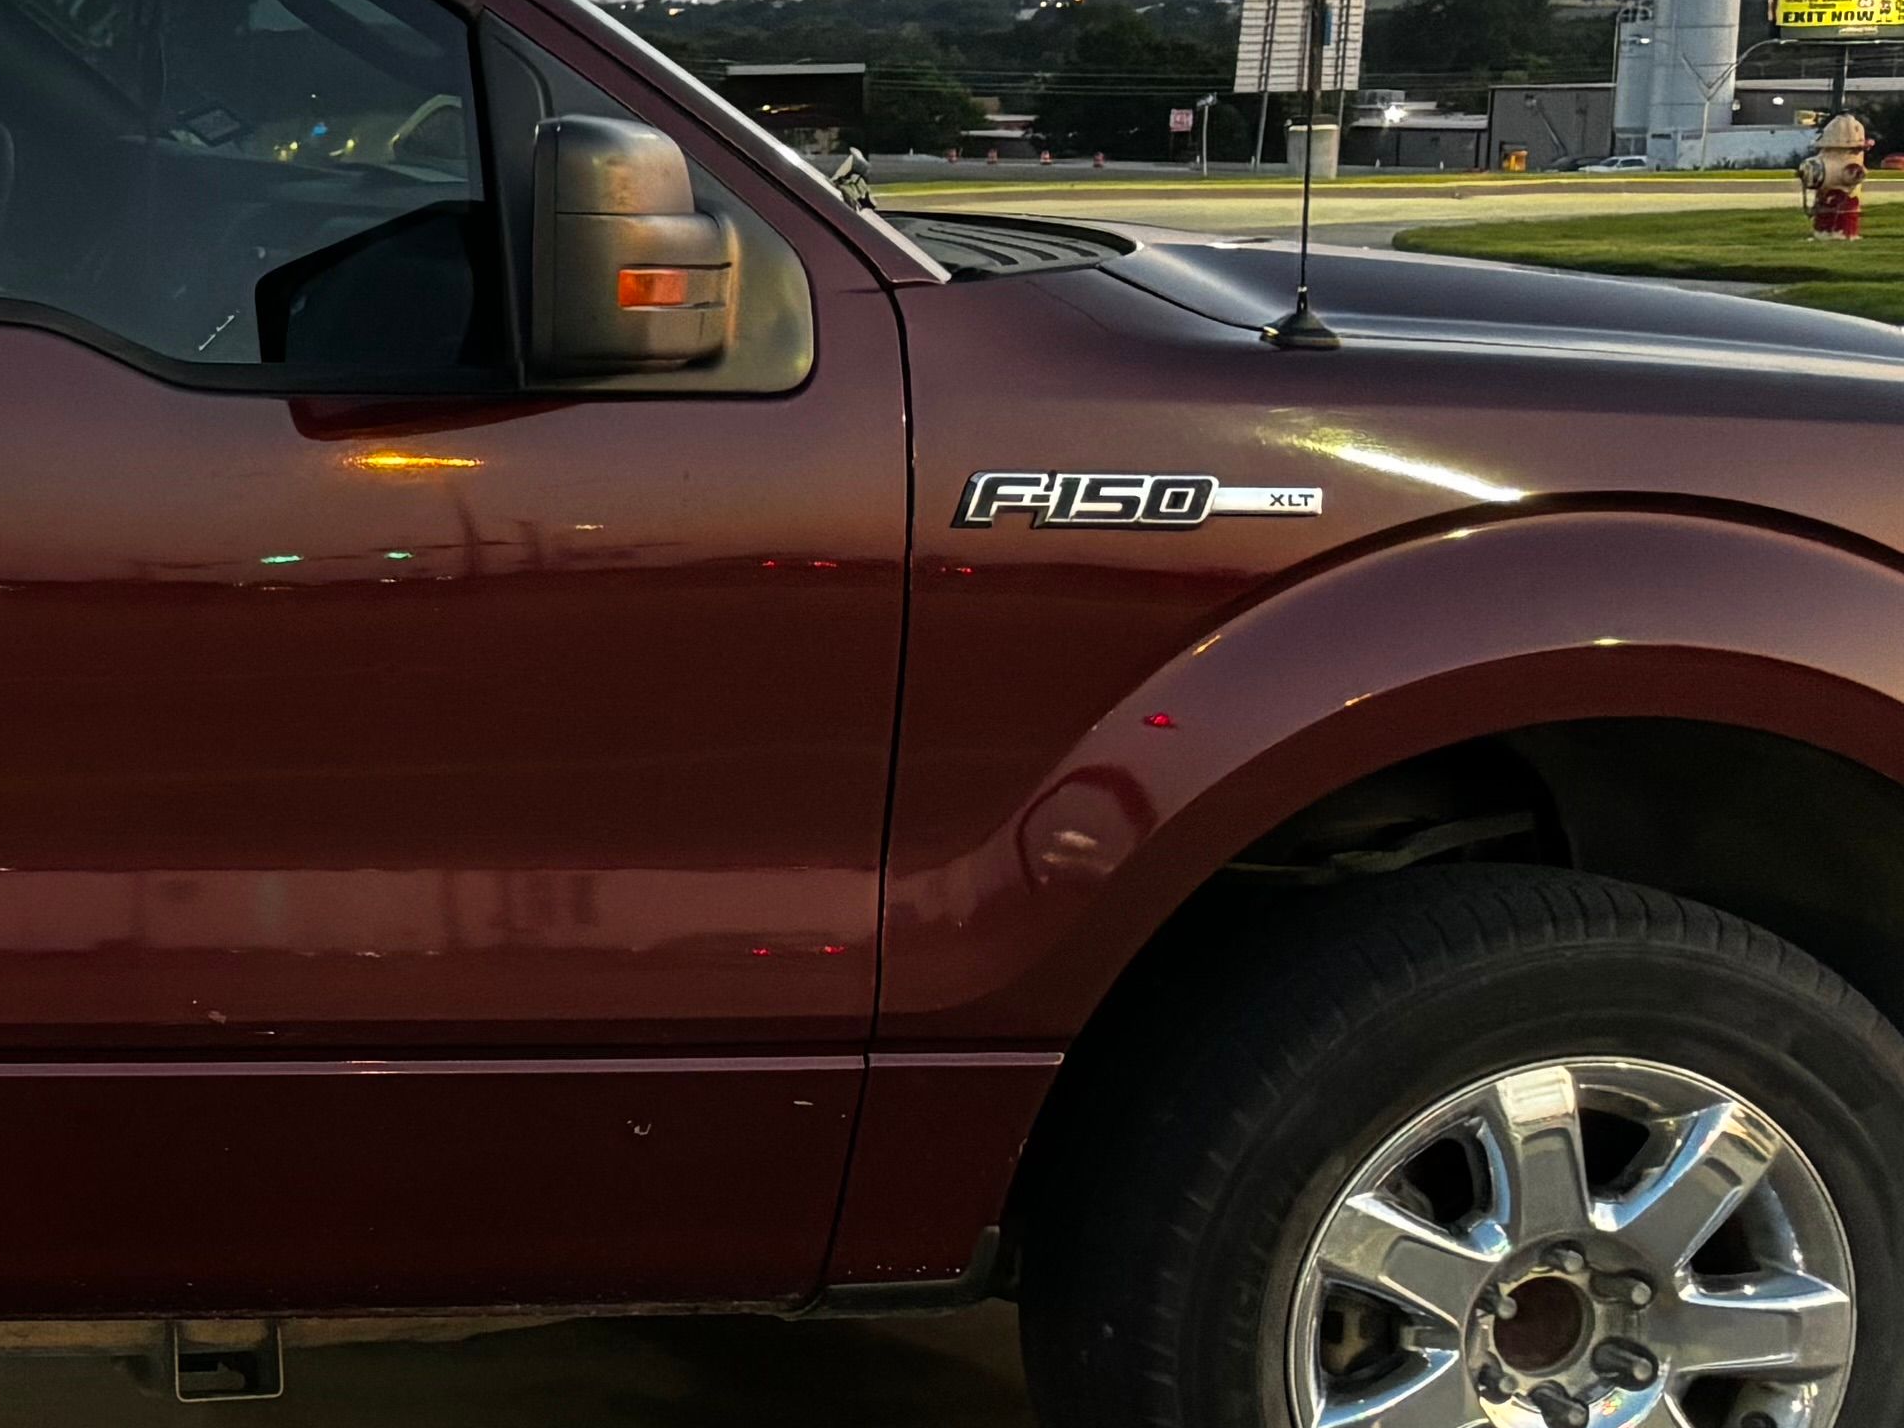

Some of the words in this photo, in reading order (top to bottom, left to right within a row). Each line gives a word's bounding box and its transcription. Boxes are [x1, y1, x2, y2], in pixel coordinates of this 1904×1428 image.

[1782, 11, 1828, 24] EXIT
[1831, 10, 1875, 22] NOW
[955, 470, 1219, 528] F-150
[1269, 492, 1315, 508] XLT
